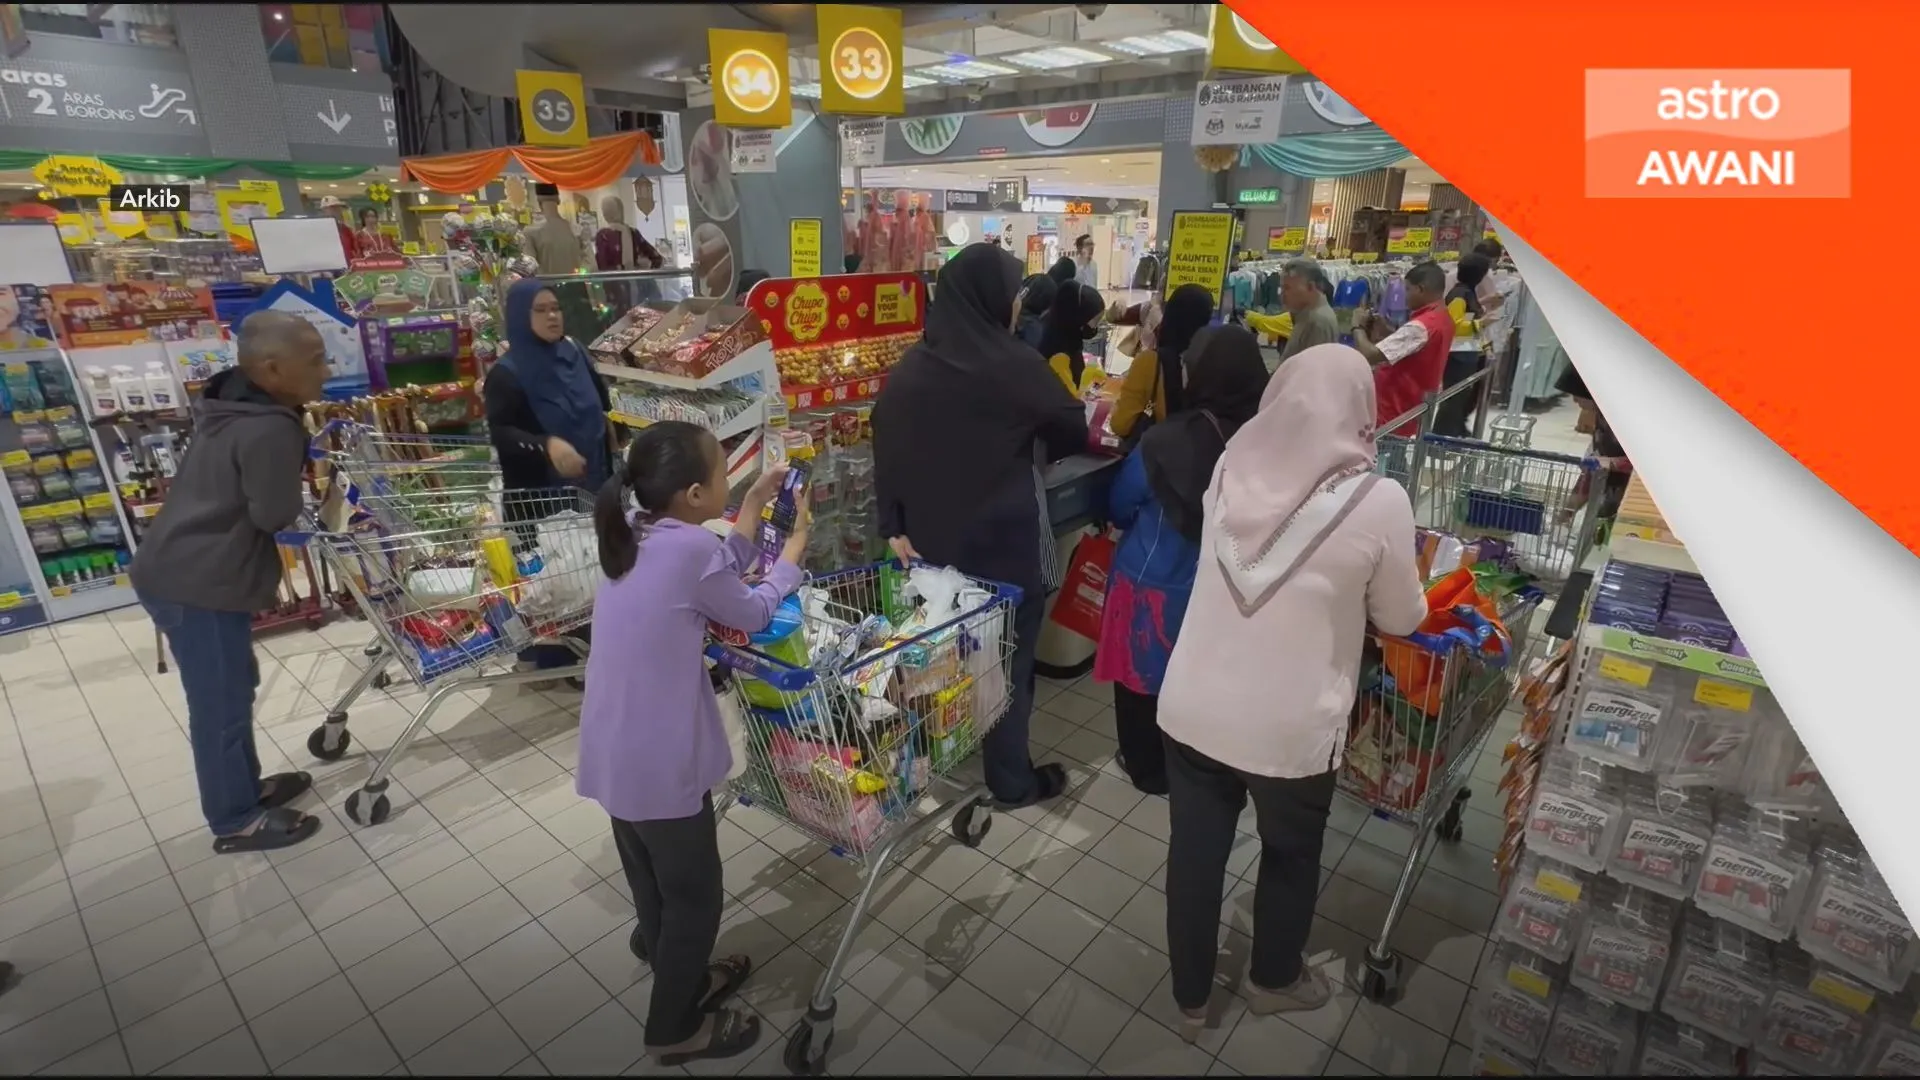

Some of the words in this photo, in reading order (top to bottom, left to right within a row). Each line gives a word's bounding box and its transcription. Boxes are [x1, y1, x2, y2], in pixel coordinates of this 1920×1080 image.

[841, 47, 883, 79] 33
[1, 69, 67, 87] aras
[732, 67, 772, 96] 34
[63, 92, 104, 106] ARAS
[1211, 95, 1236, 104] ASAS
[1236, 93, 1280, 103] RAHMAH
[1213, 83, 1281, 95] SUMBANGAN
[28, 88, 58, 115] 2
[538, 99, 569, 123] 35
[66, 105, 135, 121] BORONG
[1176, 253, 1219, 263] KAUNTER
[792, 295, 824, 310] Chupa
[790, 310, 823, 325] Chups
[1585, 701, 1657, 721] Energizer
[1539, 802, 1604, 824] Energizer
[1630, 830, 1703, 851] Energizer
[1711, 856, 1790, 884] Energizer
[1821, 899, 1911, 937] Energizer
[1771, 1001, 1844, 1027] Energizer
